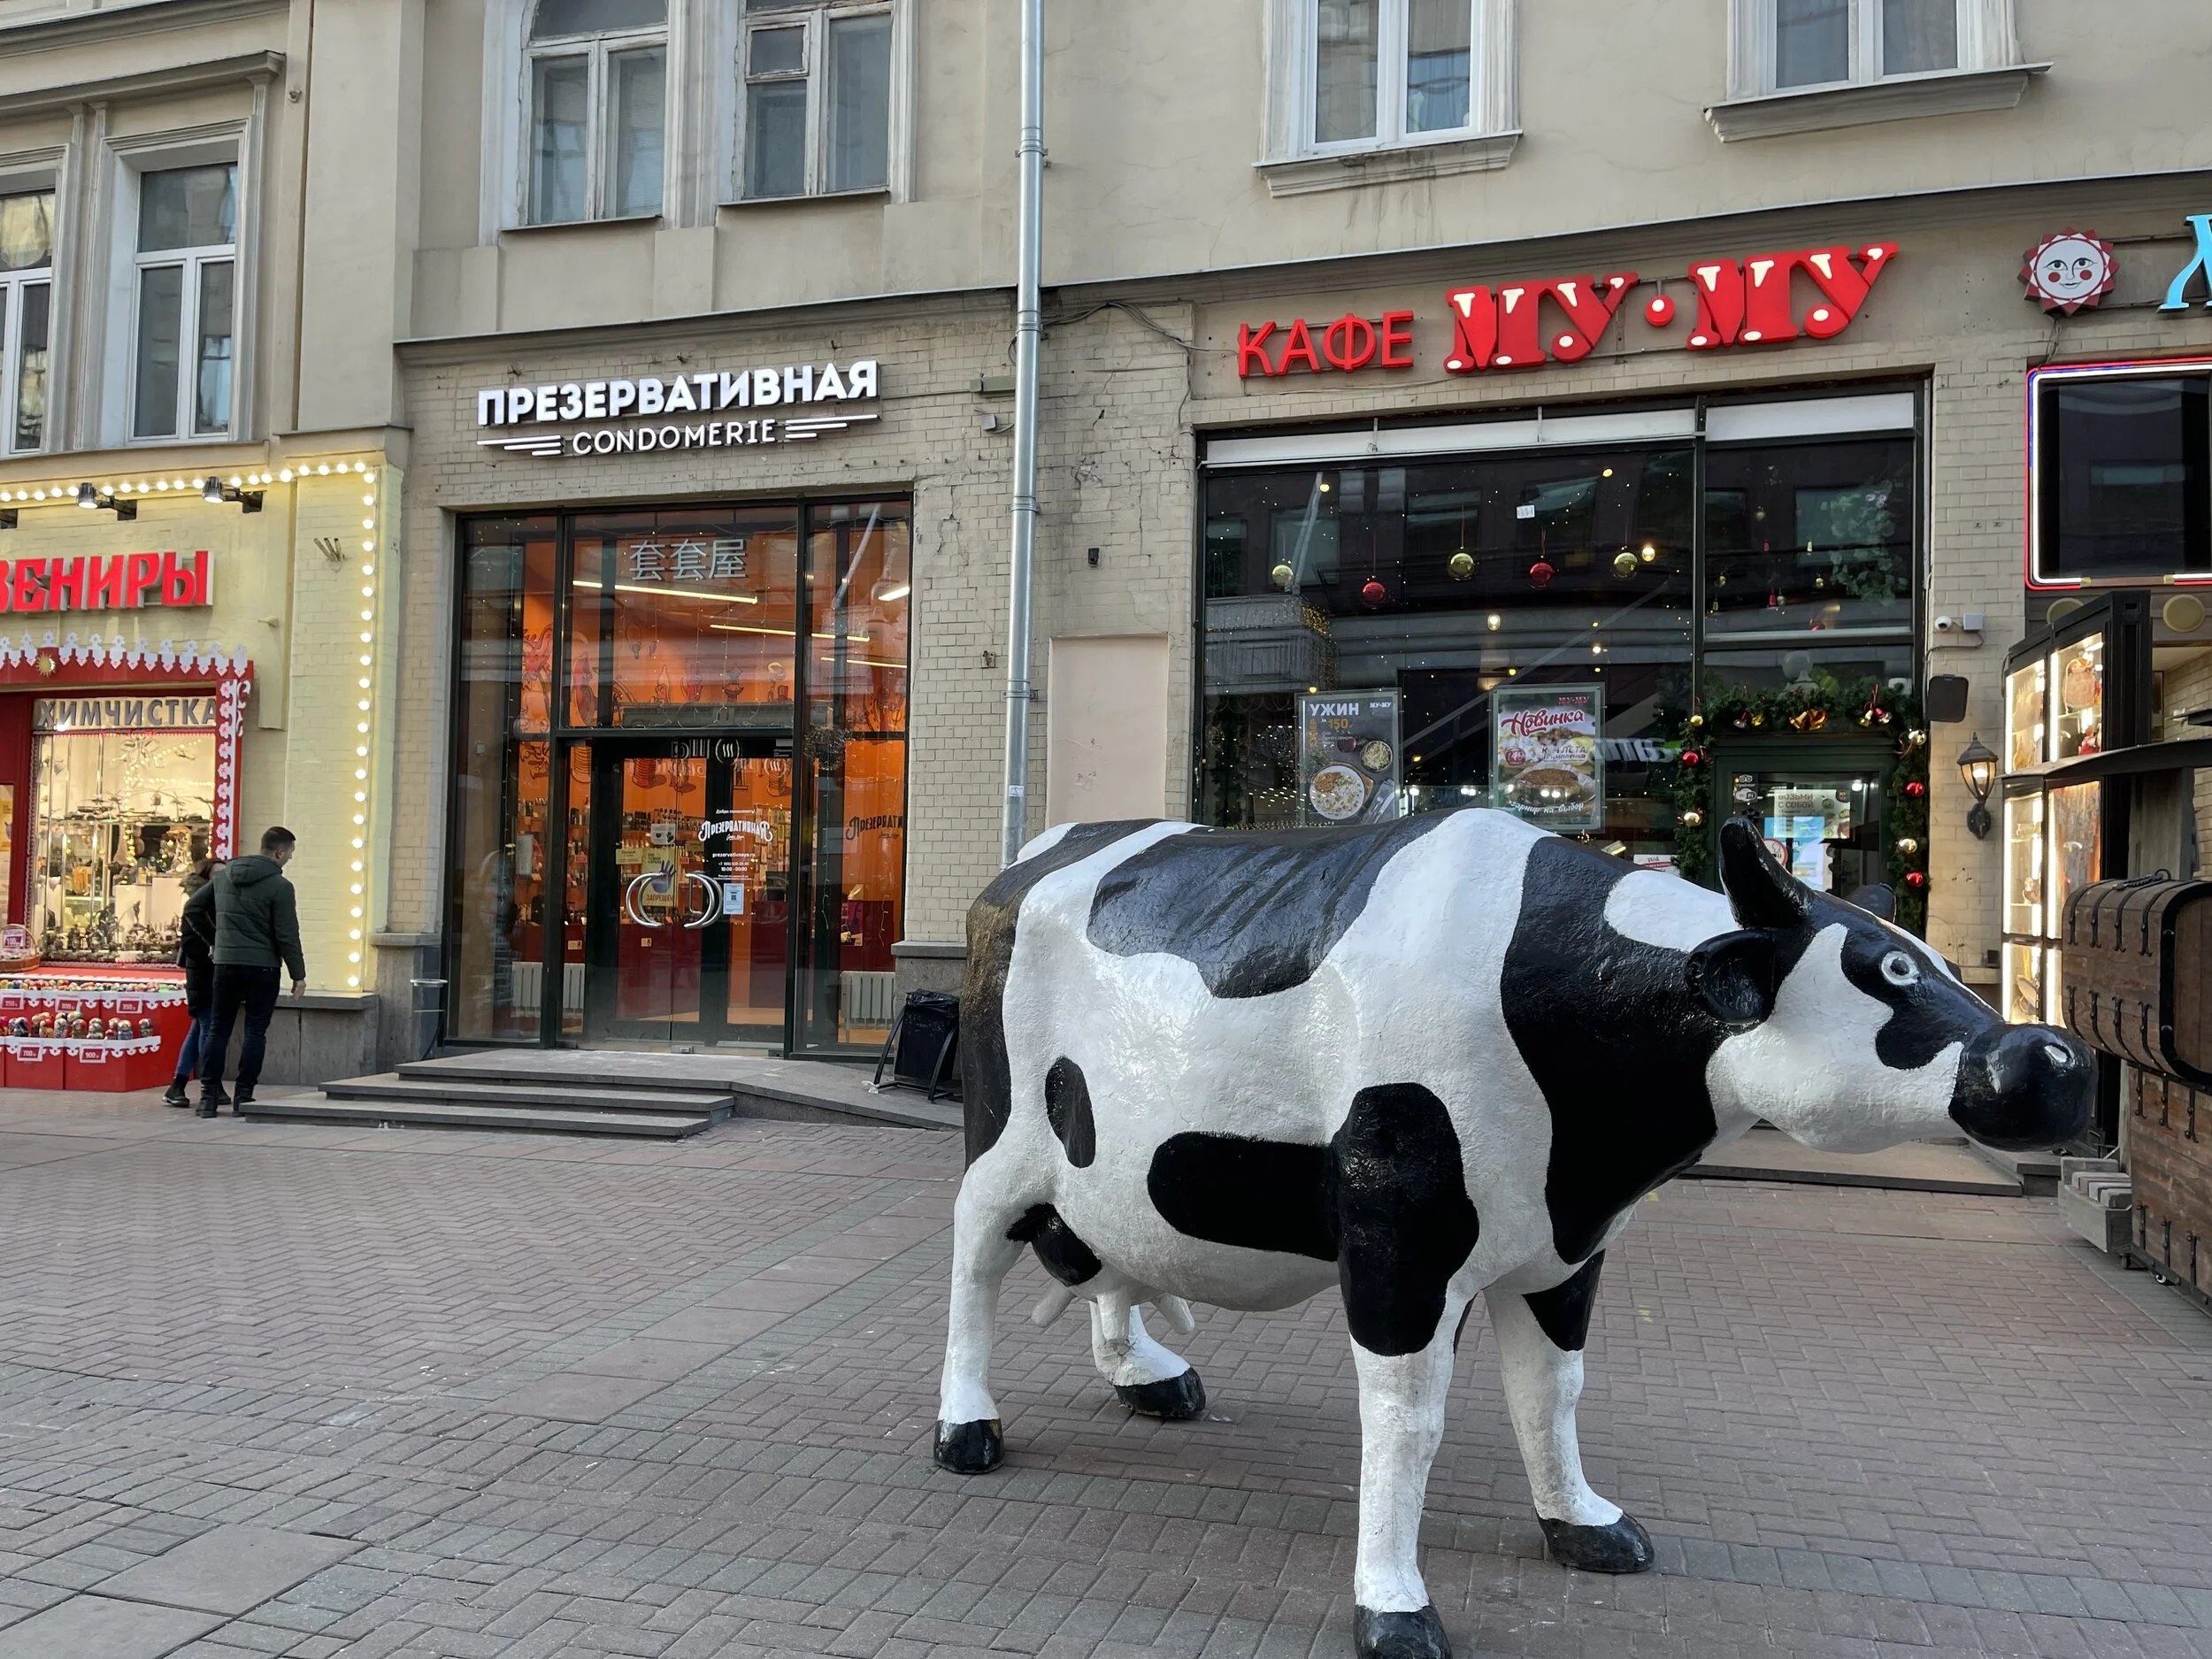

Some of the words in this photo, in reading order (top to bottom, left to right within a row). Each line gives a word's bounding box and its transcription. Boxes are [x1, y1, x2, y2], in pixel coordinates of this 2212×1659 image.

[1239, 310, 1414, 378] КАФЕ
[477, 359, 879, 426] ПРЕЗЕРВАТИВНАЯ
[572, 419, 777, 455] CONDOMERIE
[629, 538, 746, 580] 套套屋
[36, 697, 216, 727] ХИМЧИСТКА
[1310, 703, 1359, 717] УЖИН
[1501, 708, 1585, 737] Новинка
